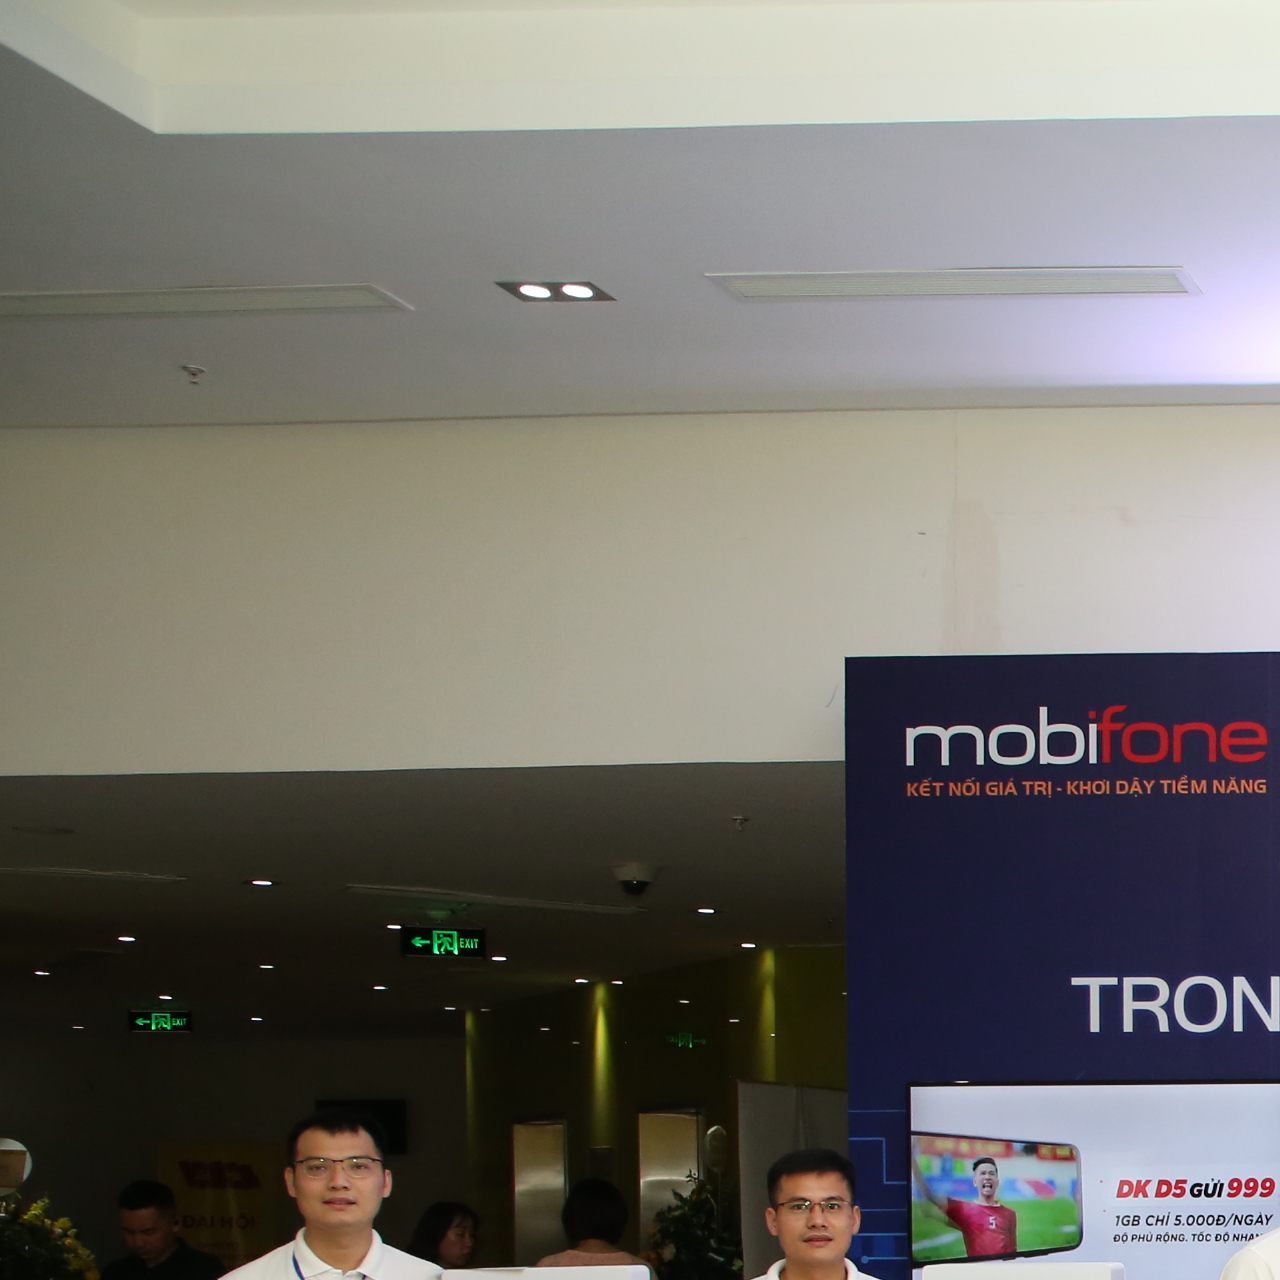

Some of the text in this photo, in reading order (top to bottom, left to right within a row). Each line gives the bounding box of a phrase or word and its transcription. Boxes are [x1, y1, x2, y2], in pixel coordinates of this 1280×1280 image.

[905, 704, 1268, 766] mobifone
[907, 779, 944, 796] KẾT
[949, 778, 980, 796] NỐI
[985, 777, 1017, 796] GIÁ
[1022, 780, 1052, 798] TRỊ
[1067, 779, 1107, 795] KHƠI
[1116, 775, 1155, 798] DẬY
[1160, 774, 1207, 794] TIỀM
[1213, 776, 1267, 794] NĂNG
[459, 937, 479, 949] EXIT
[172, 1018, 187, 1026] EXIT
[1116, 1177, 1275, 1198] DK D5 GỬI 999
[1115, 1212, 1274, 1228] 1GB CHỈ 5.000Đ/NGÀY
[1113, 1232, 1128, 1244] ĐỘ
[1131, 1231, 1153, 1242] PHỦ
[1156, 1232, 1189, 1244] RỘNG.
[1191, 1231, 1212, 1242] TỐC
[1215, 1232, 1230, 1244] ĐỘ
